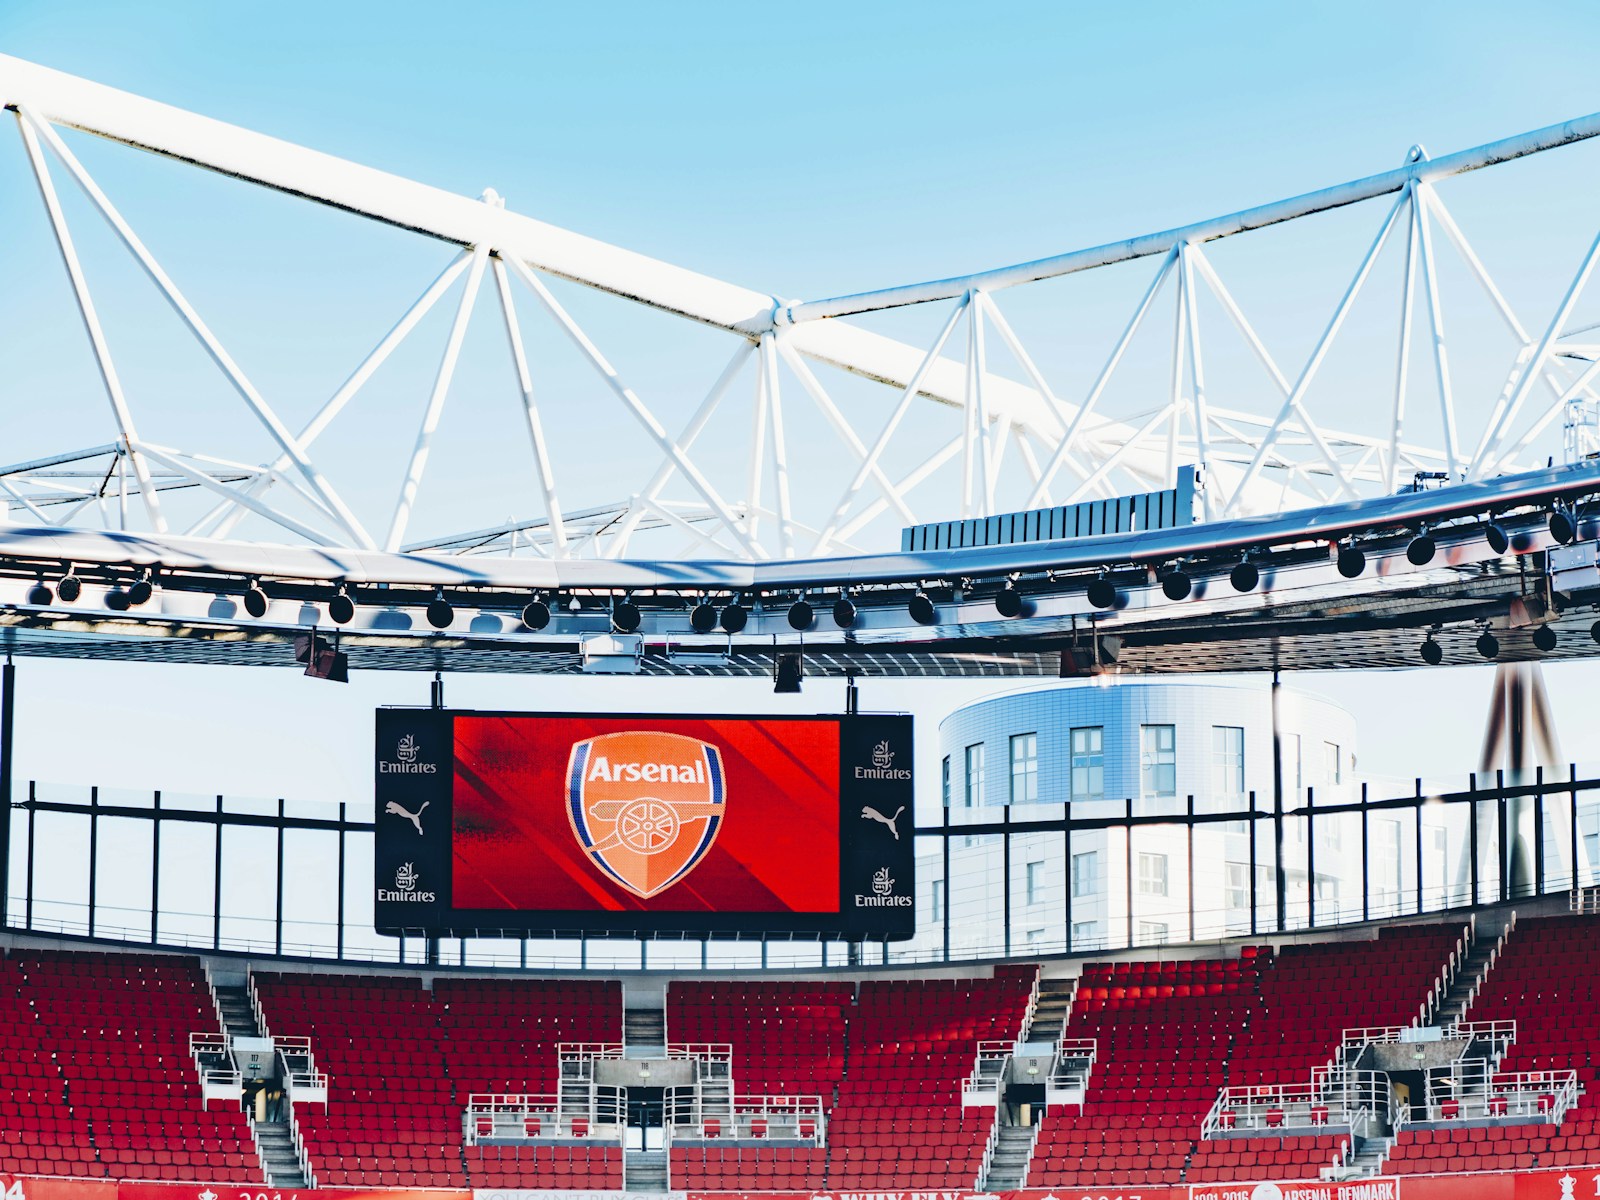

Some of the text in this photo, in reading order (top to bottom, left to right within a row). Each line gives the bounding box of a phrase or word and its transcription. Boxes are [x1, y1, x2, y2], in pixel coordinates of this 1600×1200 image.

[379, 760, 437, 774] Emirates
[588, 756, 705, 784] Arsenal
[854, 766, 912, 780] Emirates
[377, 888, 436, 903] Emirates
[855, 894, 913, 907] Emirates
